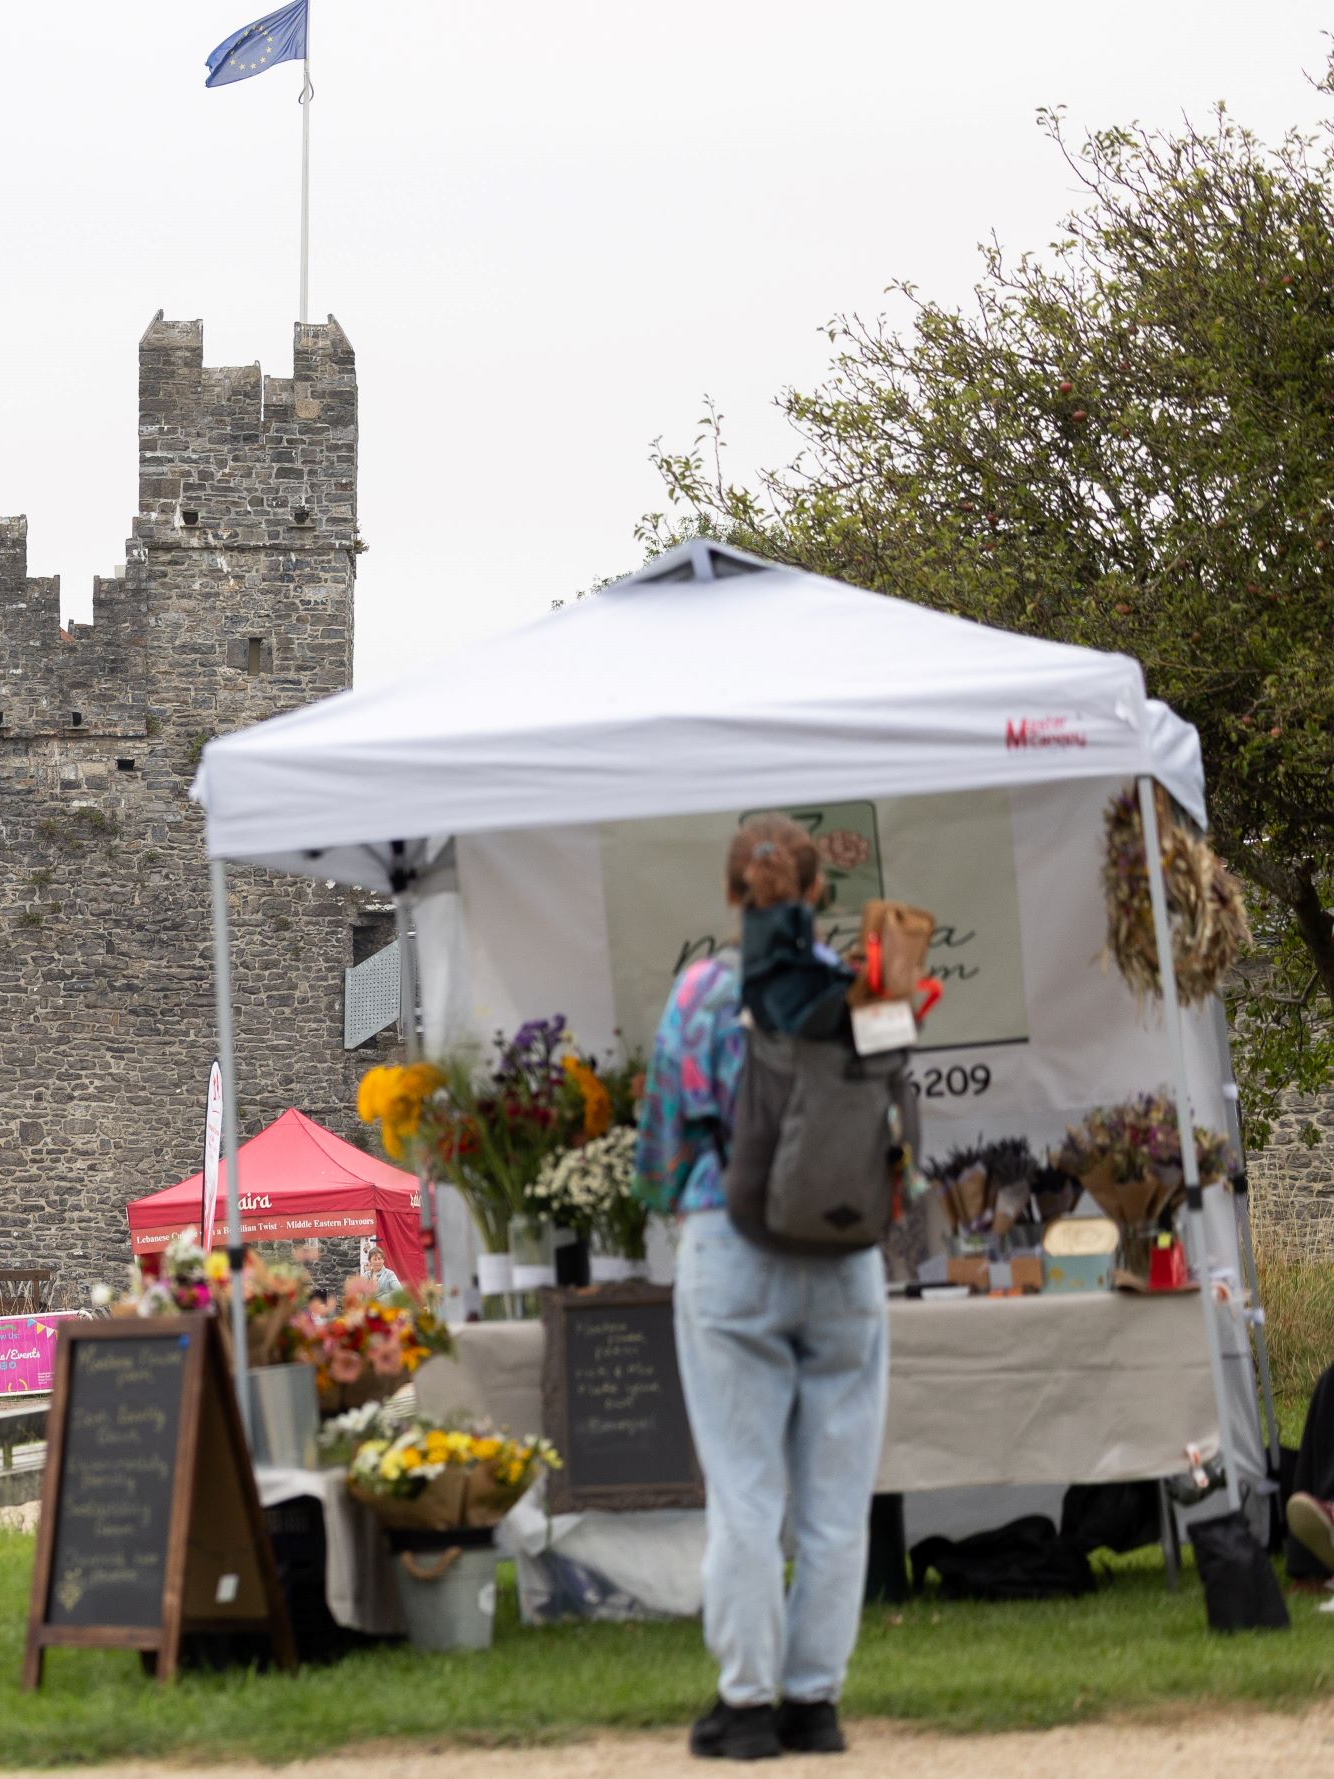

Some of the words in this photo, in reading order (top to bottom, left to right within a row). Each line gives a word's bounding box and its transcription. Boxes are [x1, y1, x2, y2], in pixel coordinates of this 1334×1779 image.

[238, 1192, 272, 1211] aira
[136, 1235, 170, 1244] Lebanese
[223, 1224, 257, 1235] Bilian
[258, 1222, 278, 1231] Twist
[286, 1219, 313, 1229] Middle
[313, 1219, 342, 1228] Eastern
[343, 1217, 374, 1226] Flavours
